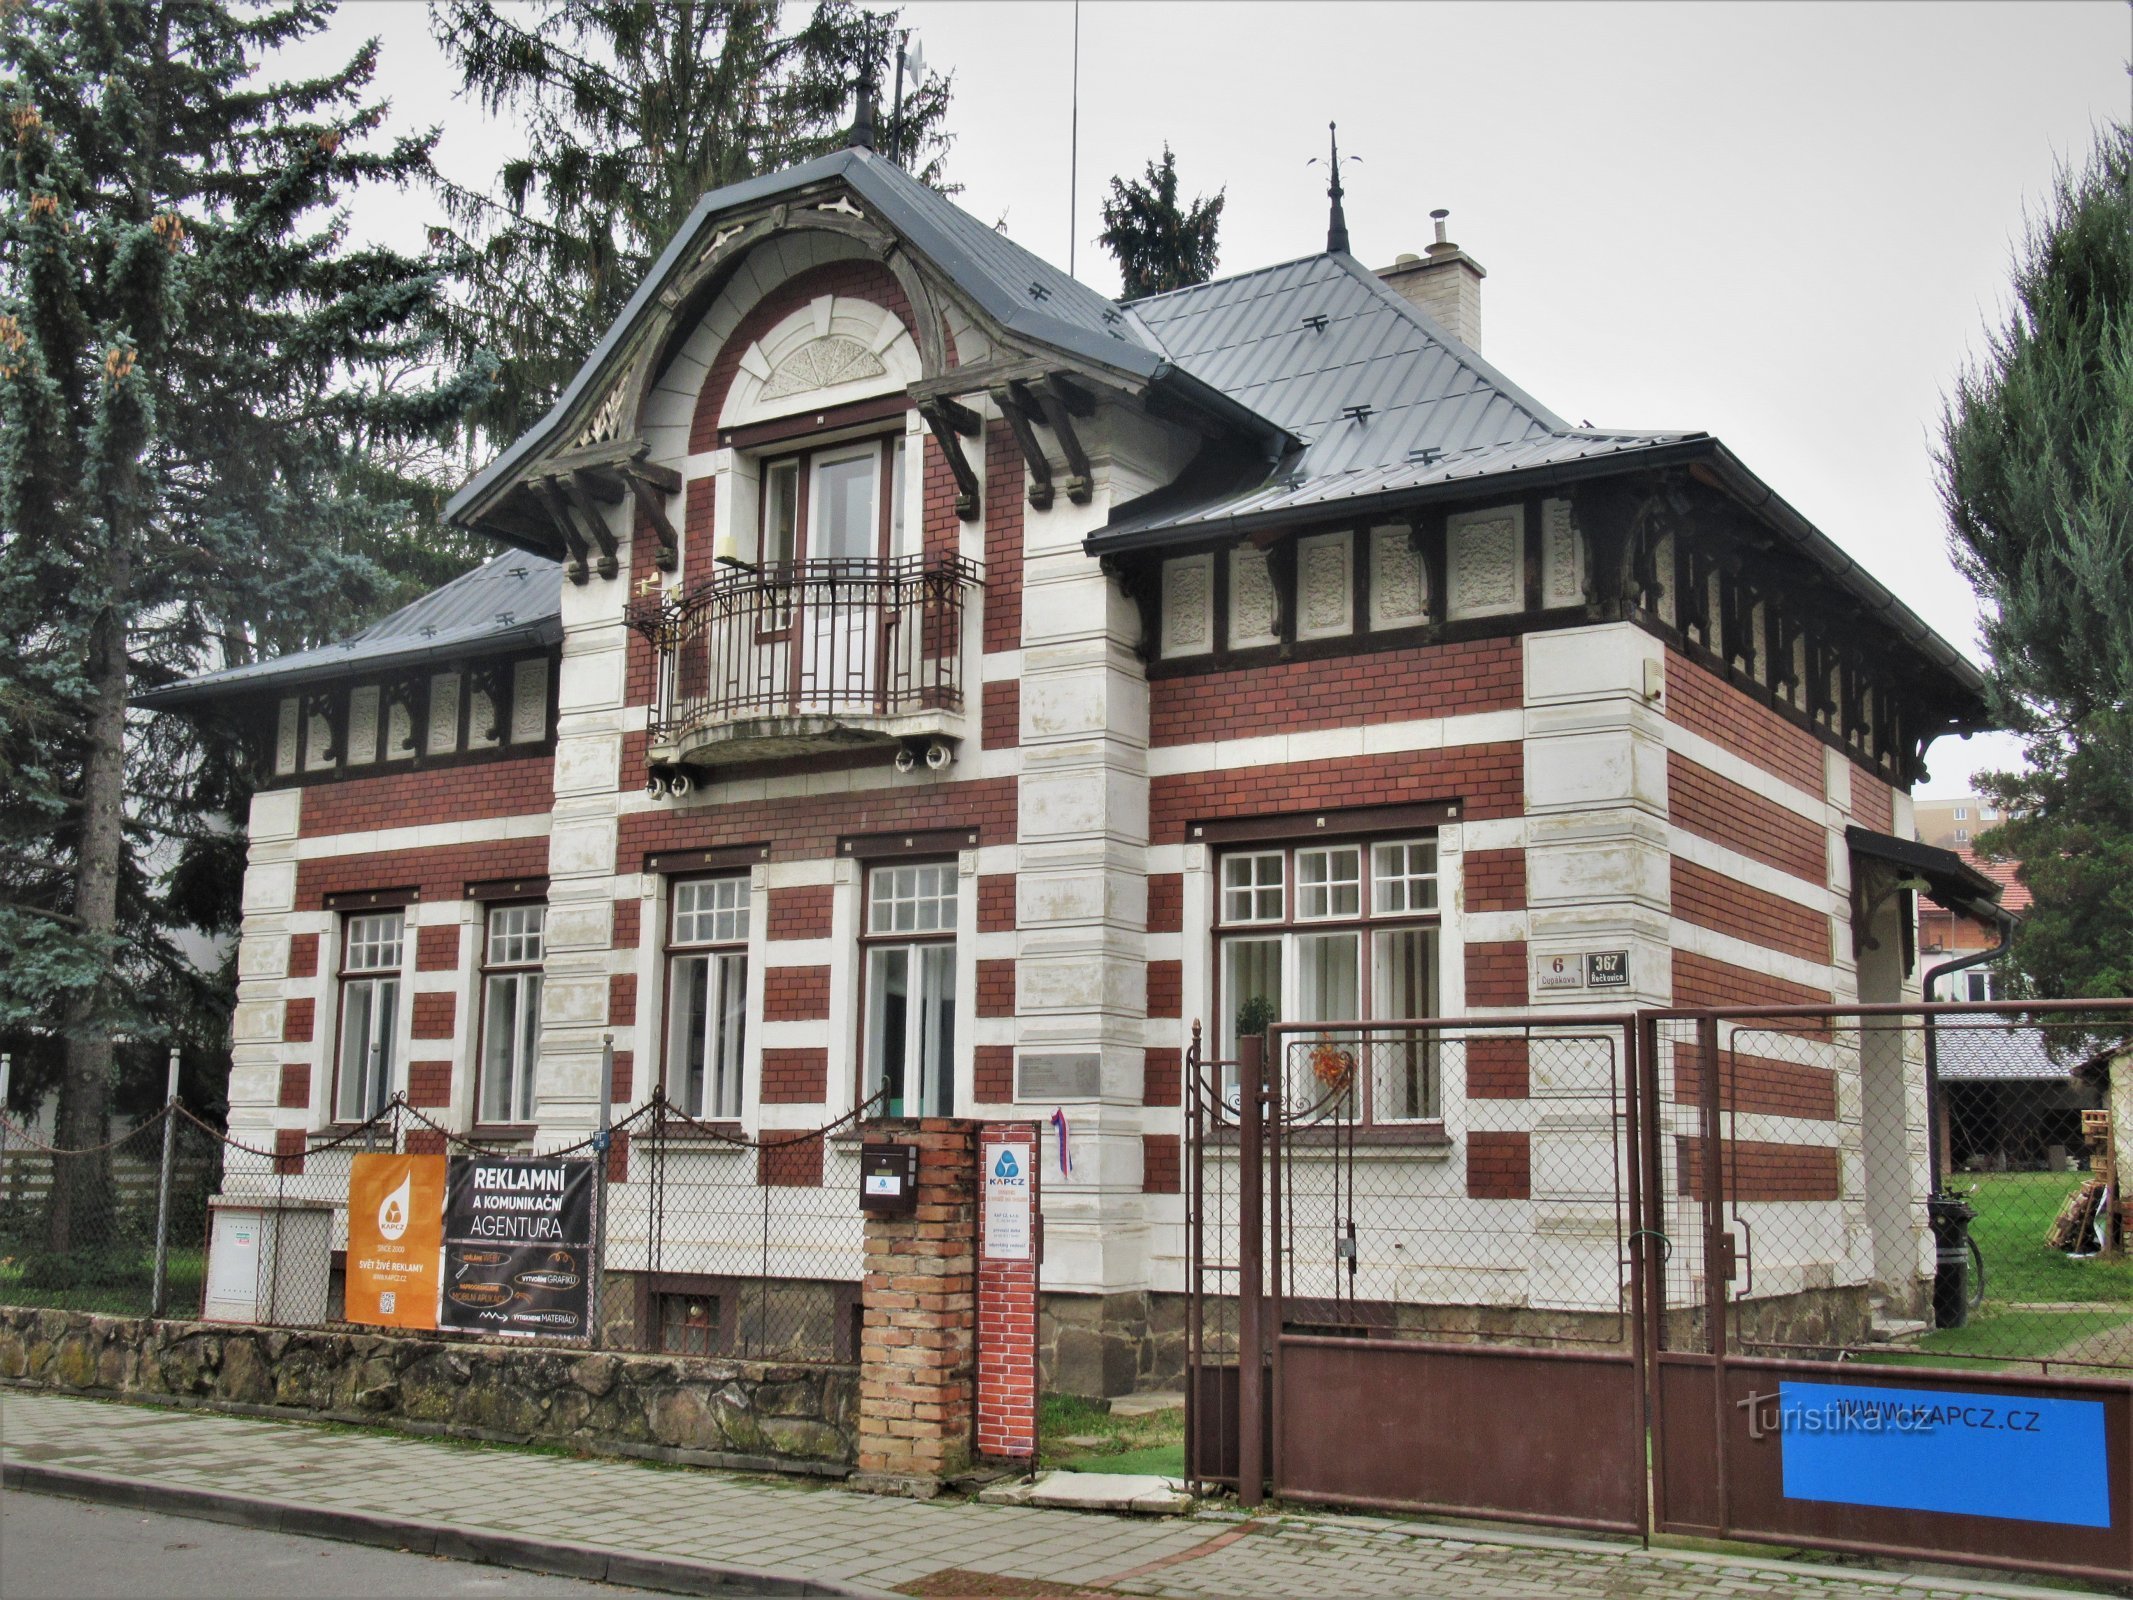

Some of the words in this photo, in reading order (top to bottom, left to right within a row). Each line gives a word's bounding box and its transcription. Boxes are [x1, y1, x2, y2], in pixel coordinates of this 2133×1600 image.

[1552, 957, 1564, 973] 6
[1595, 955, 1618, 971] 367
[1591, 972, 1624, 983] Řečkovice
[474, 1164, 566, 1191] REKLAMNÍ
[989, 1178, 1025, 1186] KAPCZ
[472, 1195, 482, 1208] A
[484, 1194, 563, 1211] KOMUNIKAČNÍ
[470, 1215, 563, 1238] AGENTURA
[377, 1244, 391, 1252] SINCE
[392, 1245, 405, 1253] 2000
[359, 1259, 375, 1269] SVĚT
[376, 1259, 391, 1271] ŽIVÉ
[392, 1262, 424, 1273] REKLAMY
[547, 1275, 576, 1284] GRAFIKU
[541, 1313, 577, 1324] MATERIÁLY
[1838, 1398, 2041, 1432] WWW.KAPCZ.CZ
